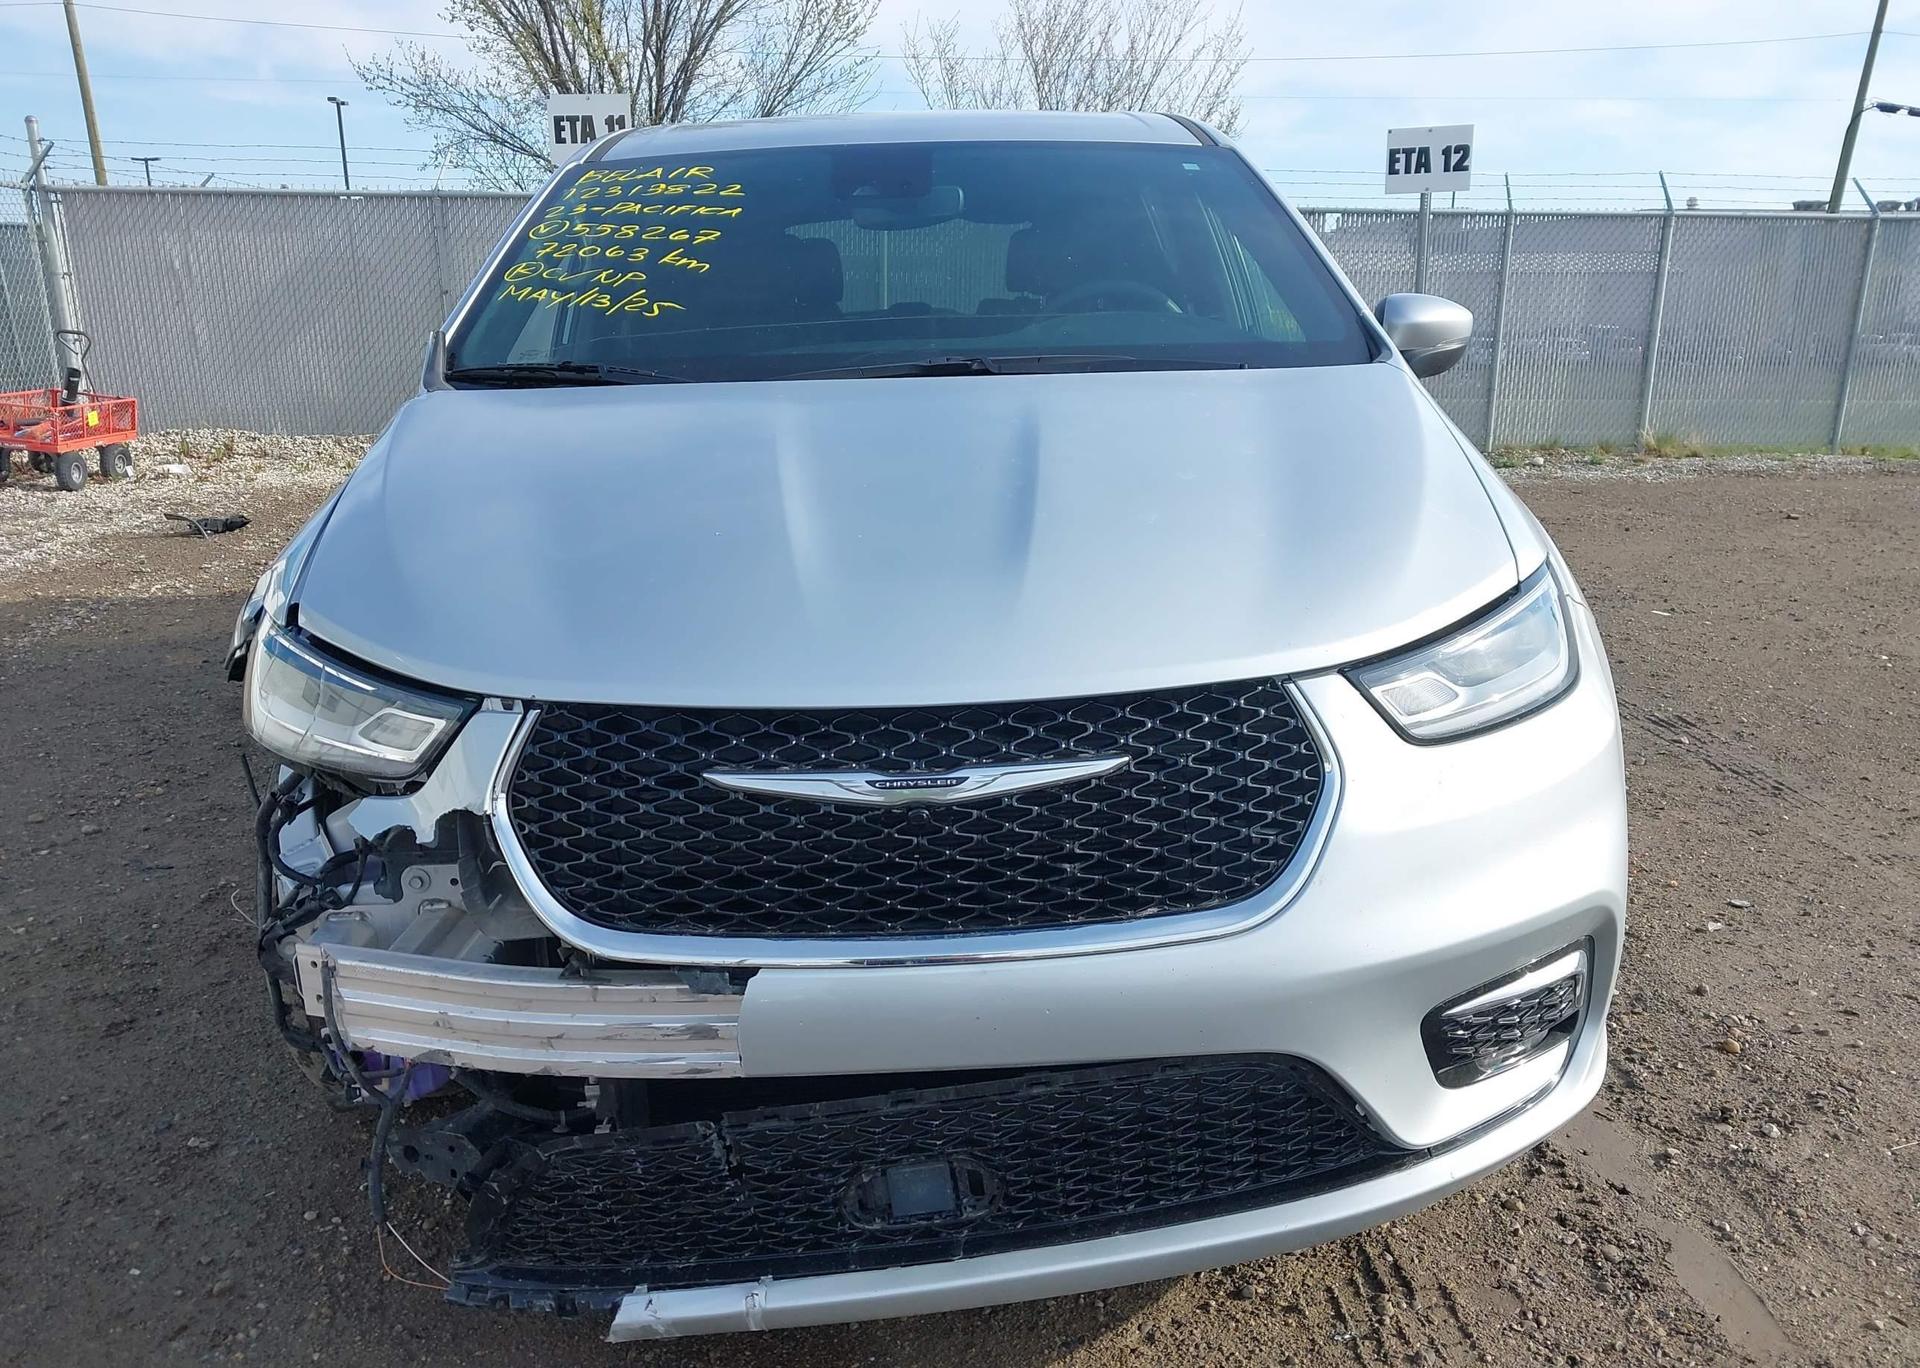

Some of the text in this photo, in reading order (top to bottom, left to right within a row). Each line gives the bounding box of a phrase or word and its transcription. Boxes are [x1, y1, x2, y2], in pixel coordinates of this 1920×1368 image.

[553, 115, 597, 144] ETA
[1388, 144, 1471, 175] ETA 12
[536, 242, 649, 261] 72063
[875, 779, 957, 788] CHRYSLER
